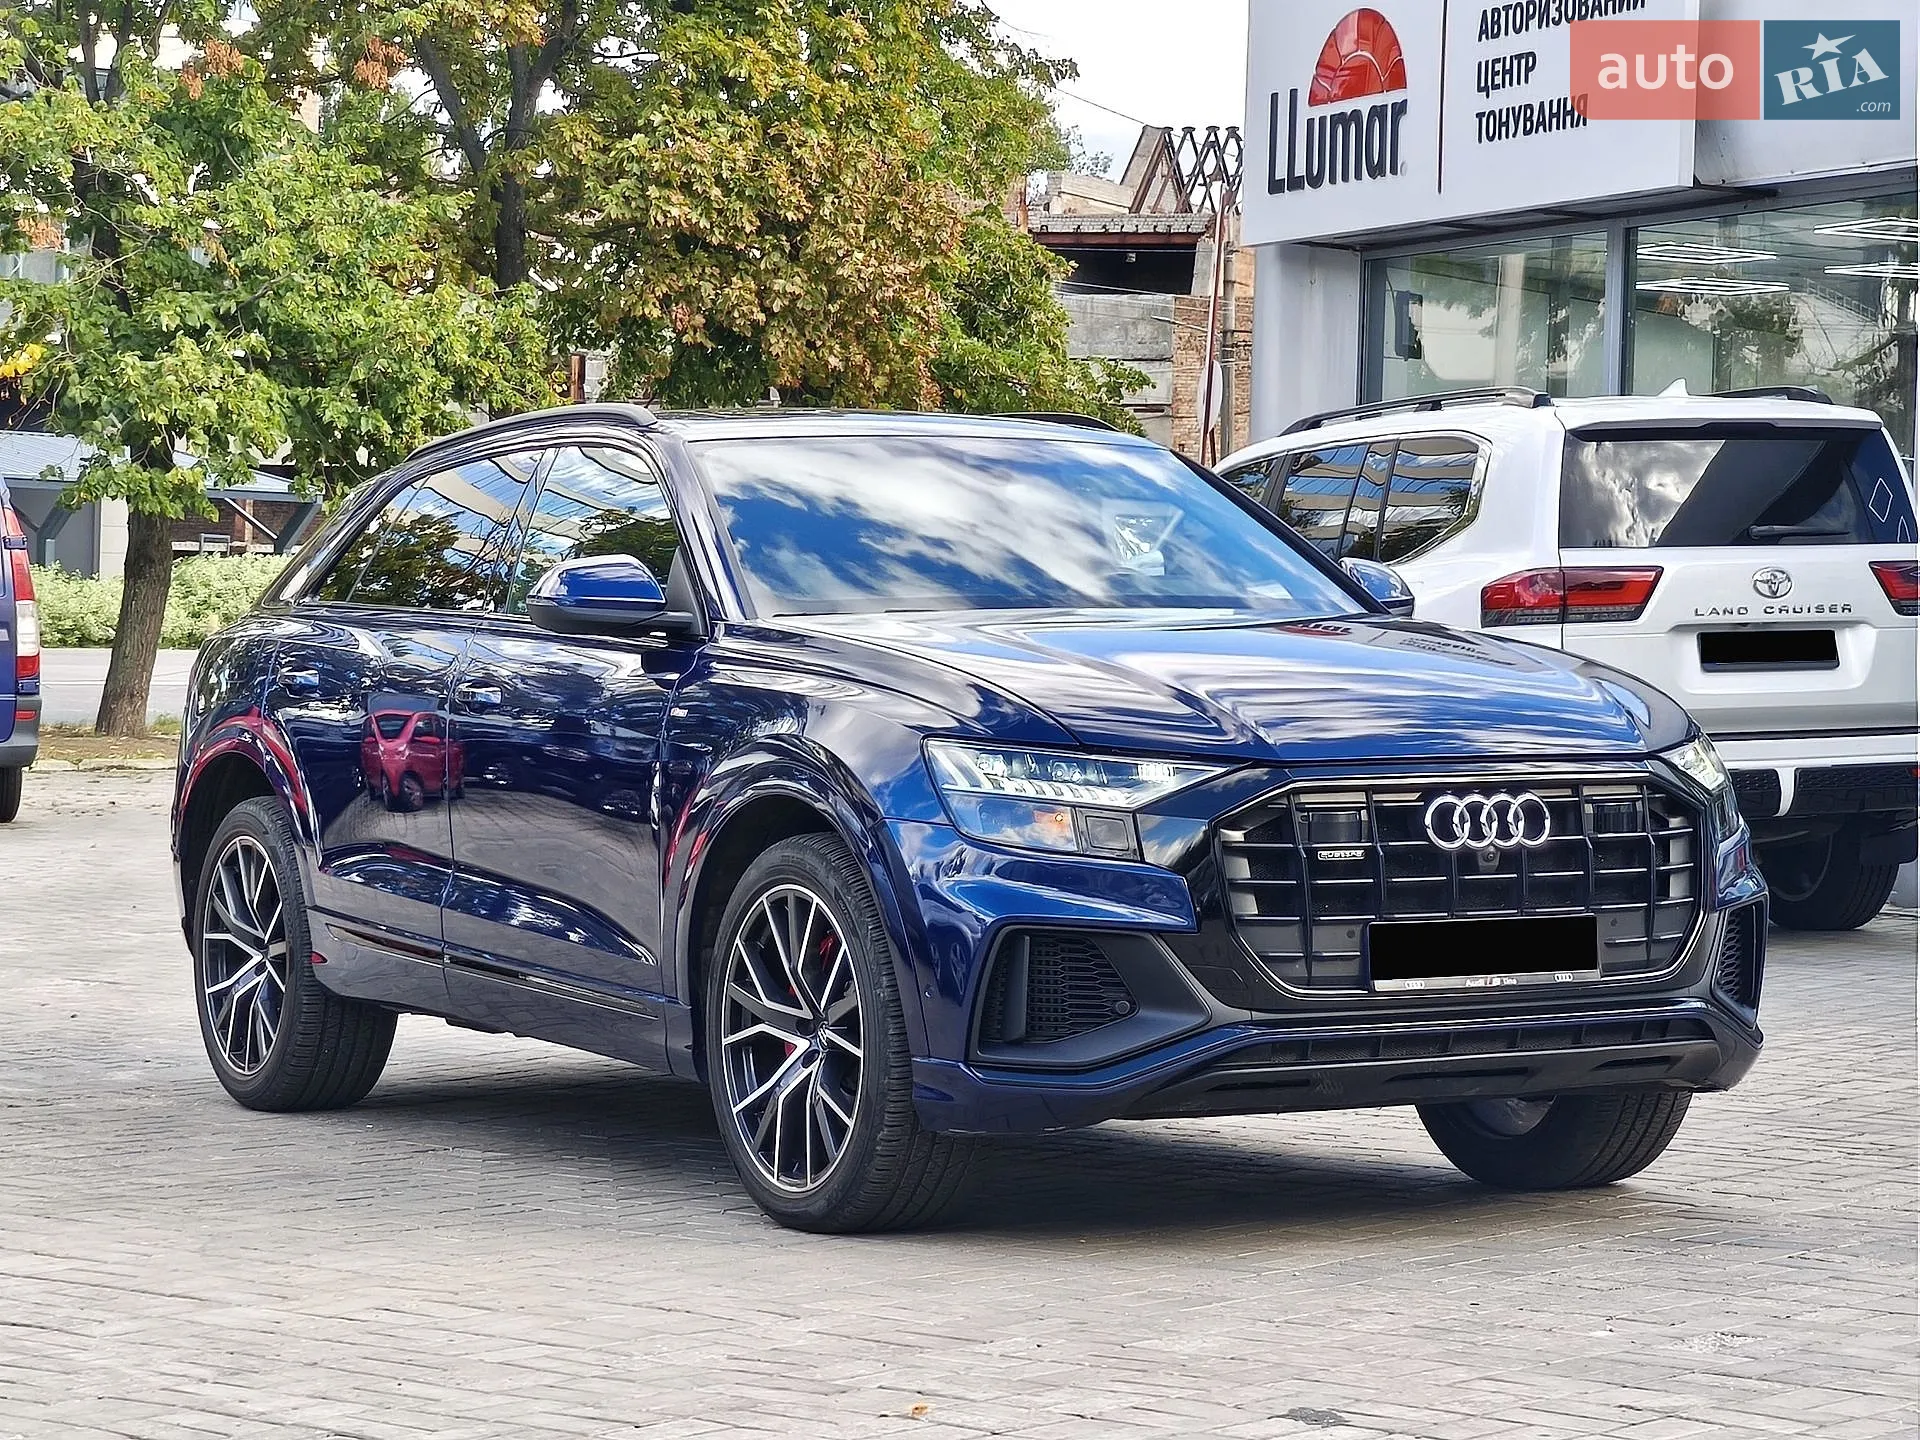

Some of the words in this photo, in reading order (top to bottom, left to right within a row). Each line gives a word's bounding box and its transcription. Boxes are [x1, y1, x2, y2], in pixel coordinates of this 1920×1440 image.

[1478, 0, 1646, 42] АВТОРИЗОВАН
[1476, 51, 1537, 99] ЦЕНТР
[1267, 88, 1408, 195] LLumar
[1475, 93, 1588, 144] ТОНУВАННЯ
[1694, 606, 1749, 617] LAND
[1763, 603, 1853, 615] CRUISER
